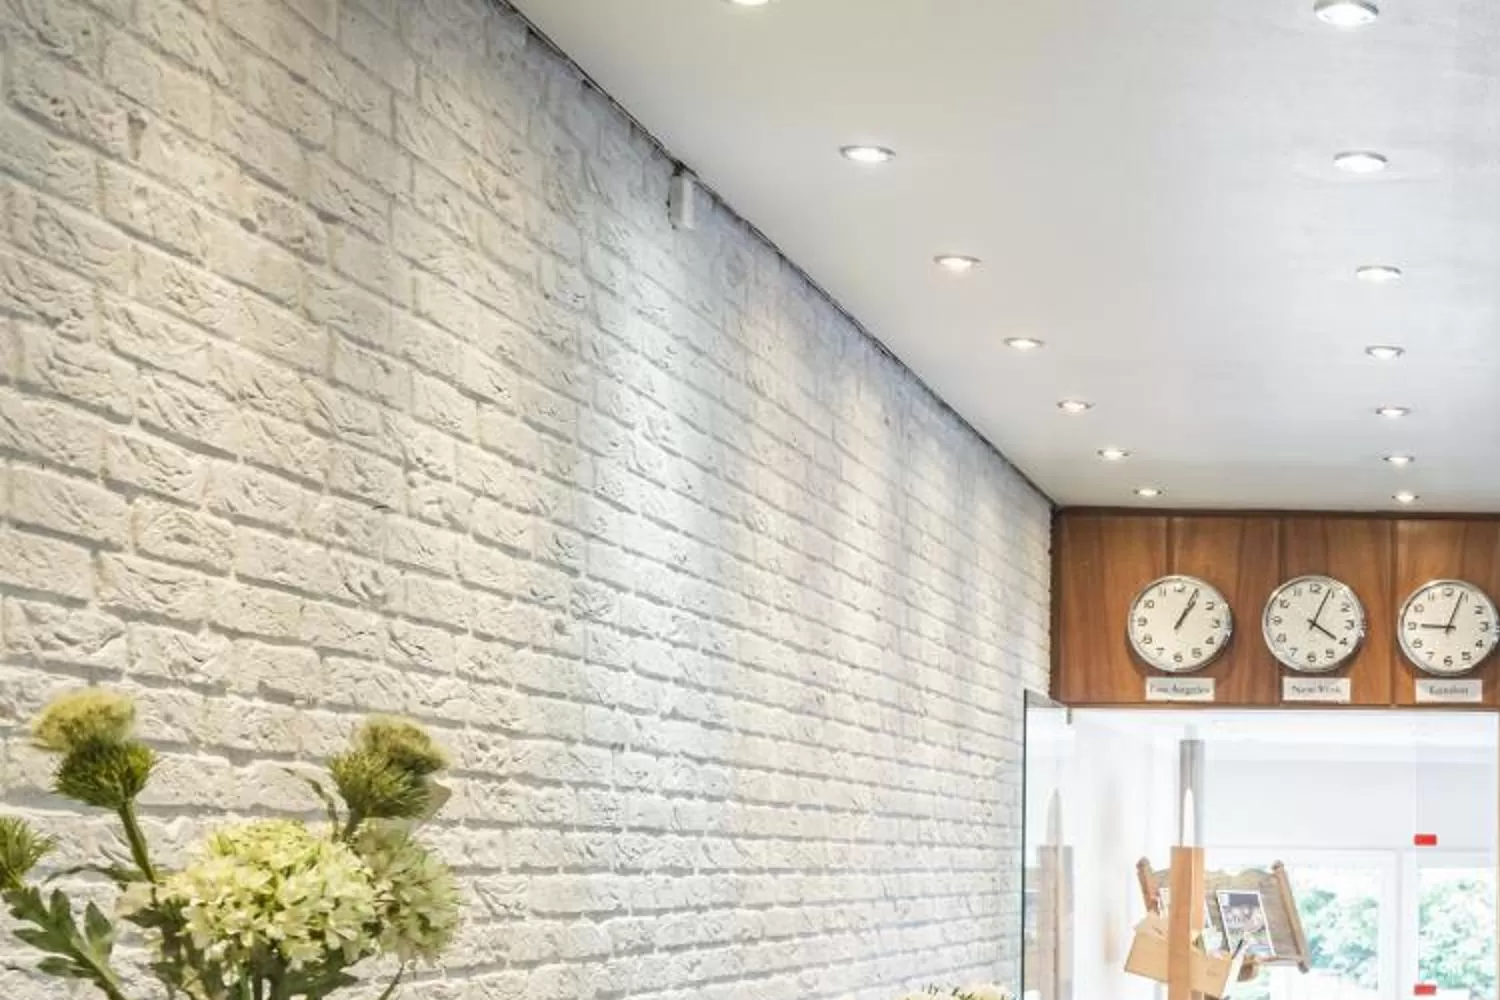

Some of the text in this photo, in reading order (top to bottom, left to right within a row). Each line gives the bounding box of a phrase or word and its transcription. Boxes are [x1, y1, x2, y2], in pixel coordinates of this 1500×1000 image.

[1310, 584, 1322, 594] 12
[1443, 588, 1454, 597] 12
[1206, 602, 1215, 611] 2
[1341, 602, 1351, 613] 2
[1475, 606, 1484, 615] 2
[1138, 618, 1148, 627] 9
[1211, 620, 1221, 629] 3
[1272, 616, 1283, 626] 9
[1345, 620, 1355, 630] 3
[1408, 622, 1417, 631] 9
[1480, 622, 1490, 632] 3
[1143, 635, 1153, 645] 8
[1206, 636, 1215, 645] 4
[1277, 634, 1287, 643] 8
[1339, 638, 1349, 646] 4
[1413, 640, 1424, 649] 8
[1476, 640, 1484, 649] 4
[1157, 648, 1165, 657] 7
[1192, 648, 1202, 659] 5
[1290, 648, 1298, 657] 7
[1326, 649, 1335, 659] 5
[1425, 652, 1435, 661] 7
[1462, 652, 1472, 661] 5
[1174, 653, 1183, 663] 6
[1307, 653, 1317, 663] 6
[1444, 656, 1454, 667] 6
